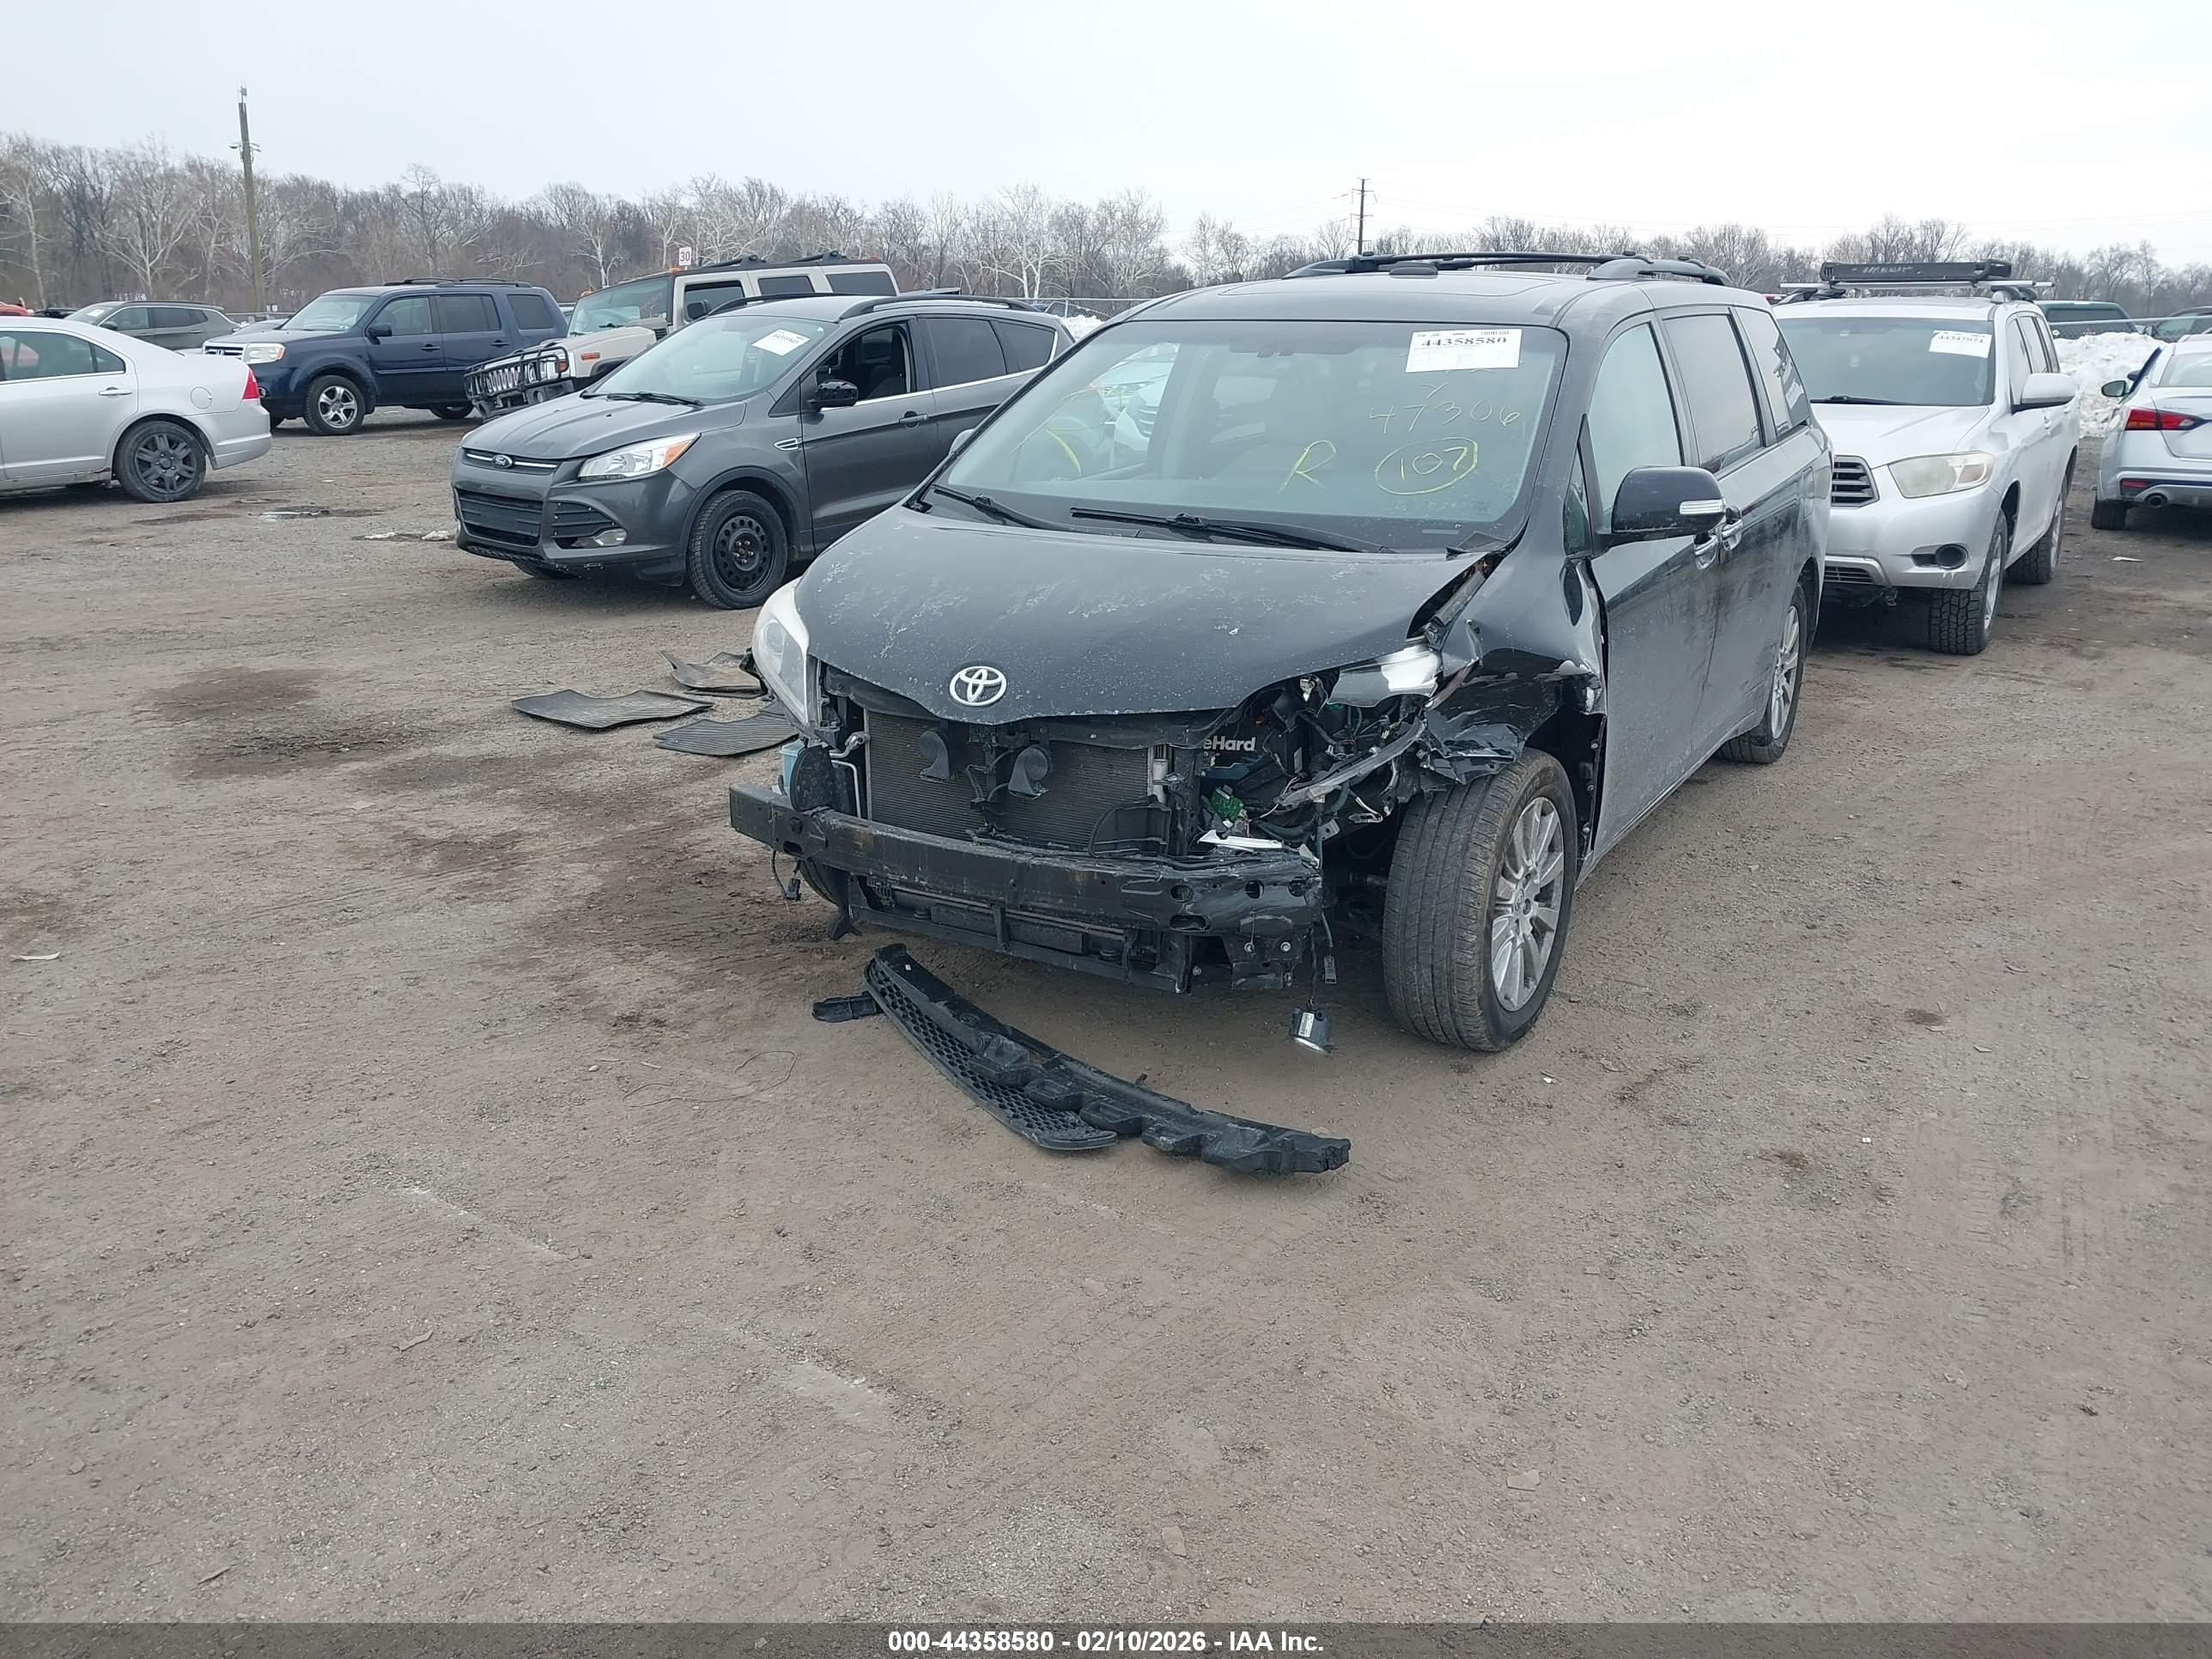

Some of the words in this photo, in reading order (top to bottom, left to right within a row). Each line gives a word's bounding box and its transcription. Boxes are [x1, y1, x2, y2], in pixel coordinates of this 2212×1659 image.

[680, 251, 690, 262] 30
[1422, 337, 1507, 347] 44358580
[1368, 398, 1521, 434] 47306
[1277, 439, 1337, 495] R
[1401, 446, 1468, 482] 107
[1203, 735, 1256, 752] eHard
